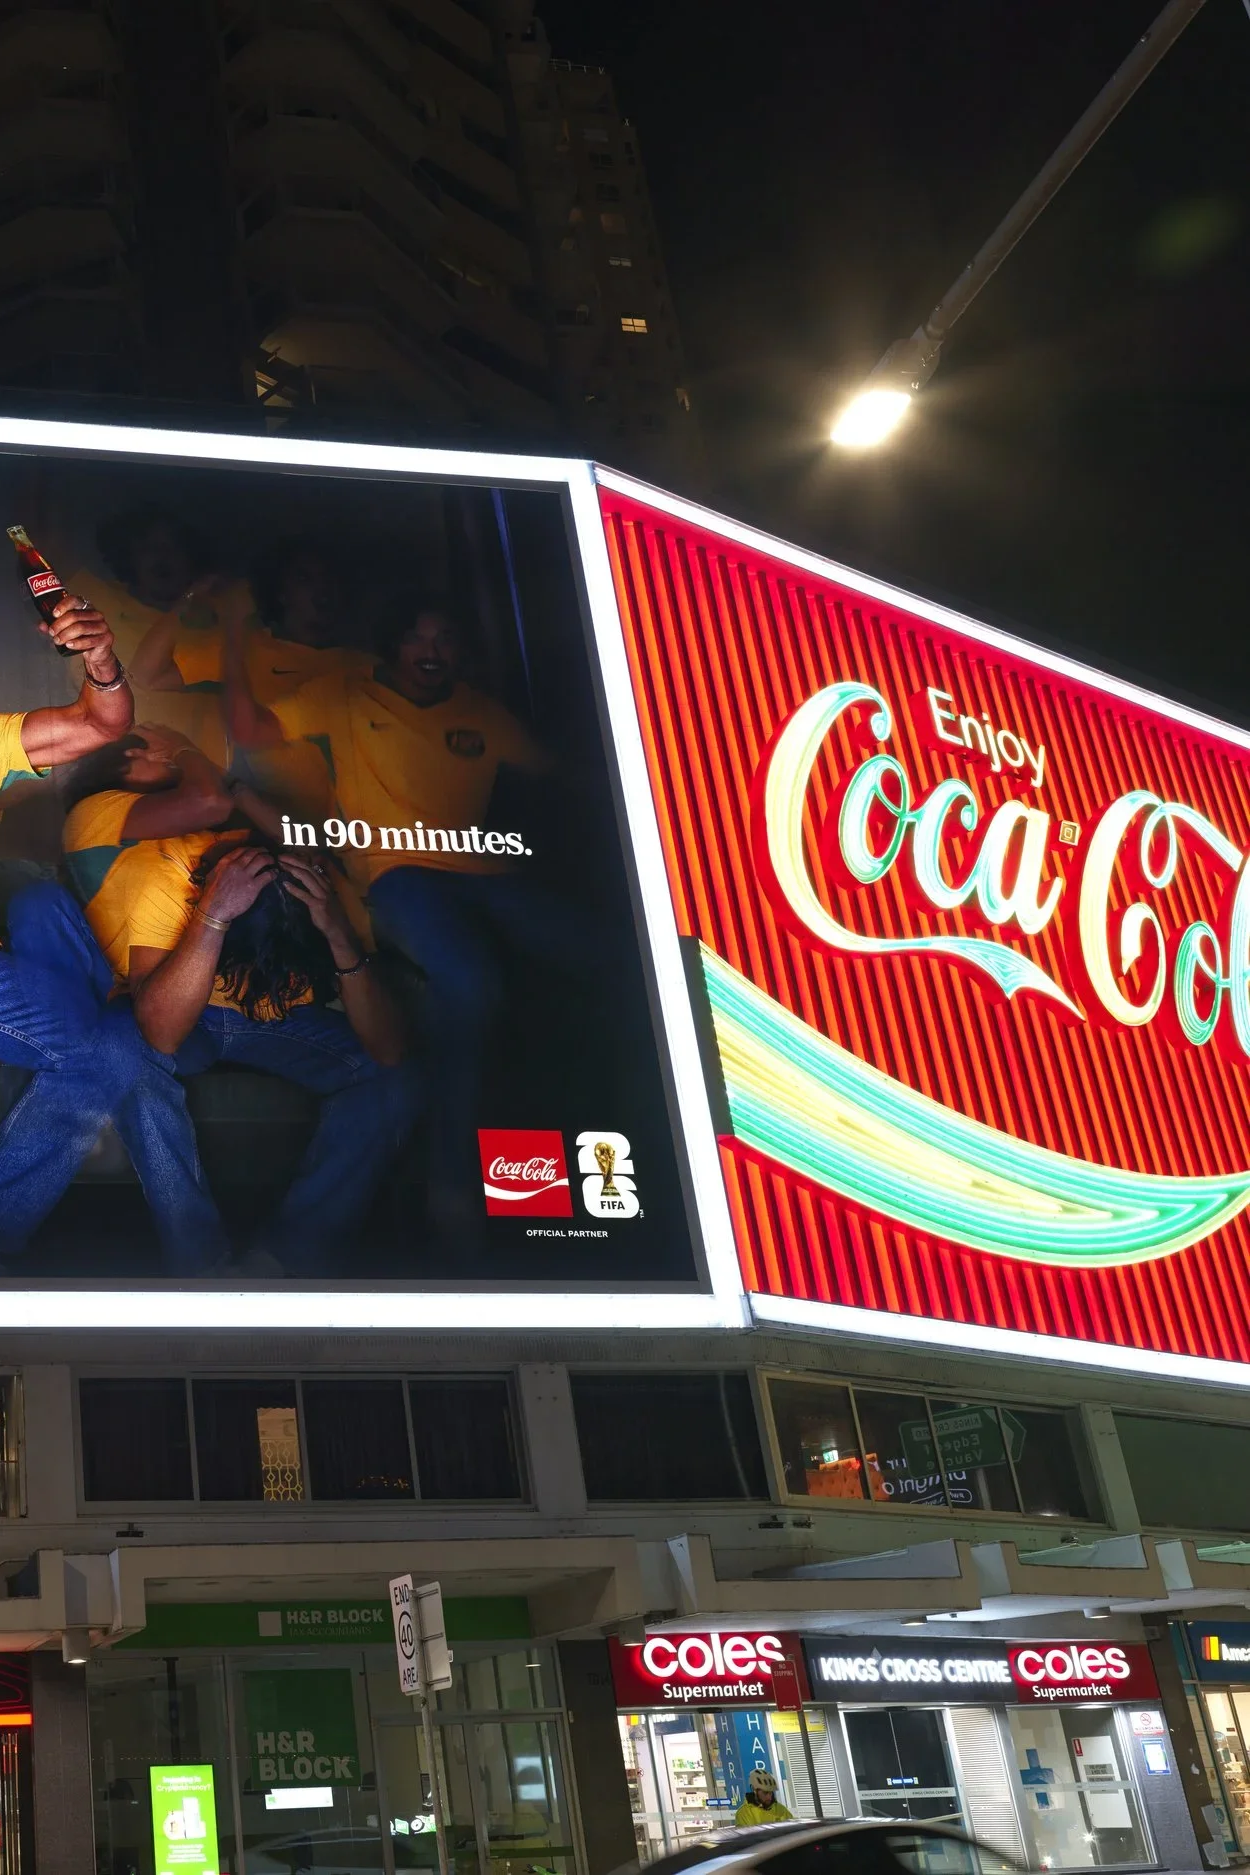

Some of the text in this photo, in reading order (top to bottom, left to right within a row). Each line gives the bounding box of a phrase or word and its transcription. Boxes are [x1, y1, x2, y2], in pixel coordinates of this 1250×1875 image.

[927, 686, 1045, 788] Enjoy
[280, 815, 533, 856] in 90 minutes.
[489, 1156, 559, 1181] Coca-Cola
[600, 1200, 625, 1210] FIFA
[526, 1229, 608, 1238] OFFICIAL PARTNER
[394, 1584, 410, 1605] END
[287, 1609, 384, 1624] H&R BLOCK
[401, 1623, 413, 1648] 40
[643, 1633, 785, 1678] coles
[1017, 1646, 1130, 1681] coles
[403, 1667, 418, 1685] ARE
[820, 1657, 1011, 1683] KINGS CROSS CENTRE
[662, 1681, 765, 1702] Supermarket
[1032, 1684, 1112, 1701] Supermarket
[256, 1731, 315, 1754] H&R
[258, 1756, 353, 1781] BLOCK
